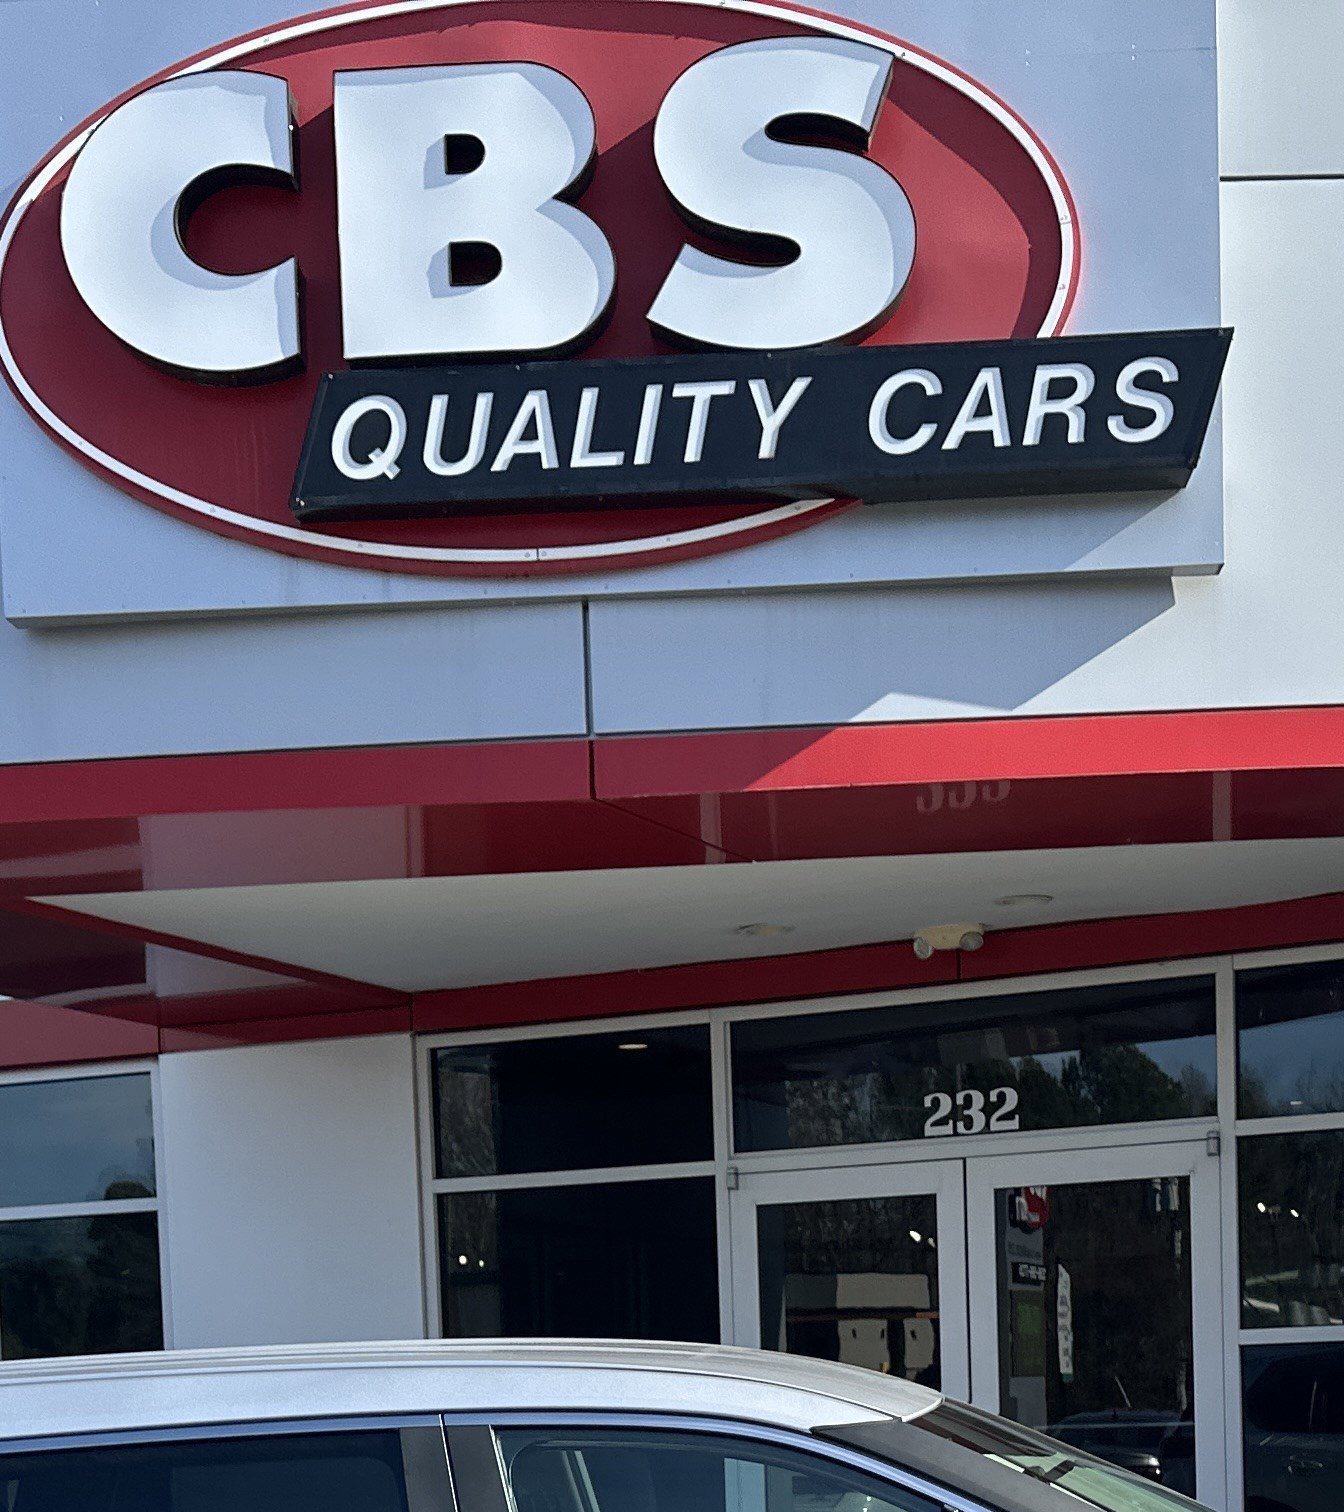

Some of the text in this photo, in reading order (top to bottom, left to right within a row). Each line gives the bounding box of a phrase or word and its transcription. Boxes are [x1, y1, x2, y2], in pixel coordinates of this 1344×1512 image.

[59, 35, 918, 387] CBS
[330, 355, 1181, 481] QUALITY CARS
[923, 1086, 1020, 1137] 232
